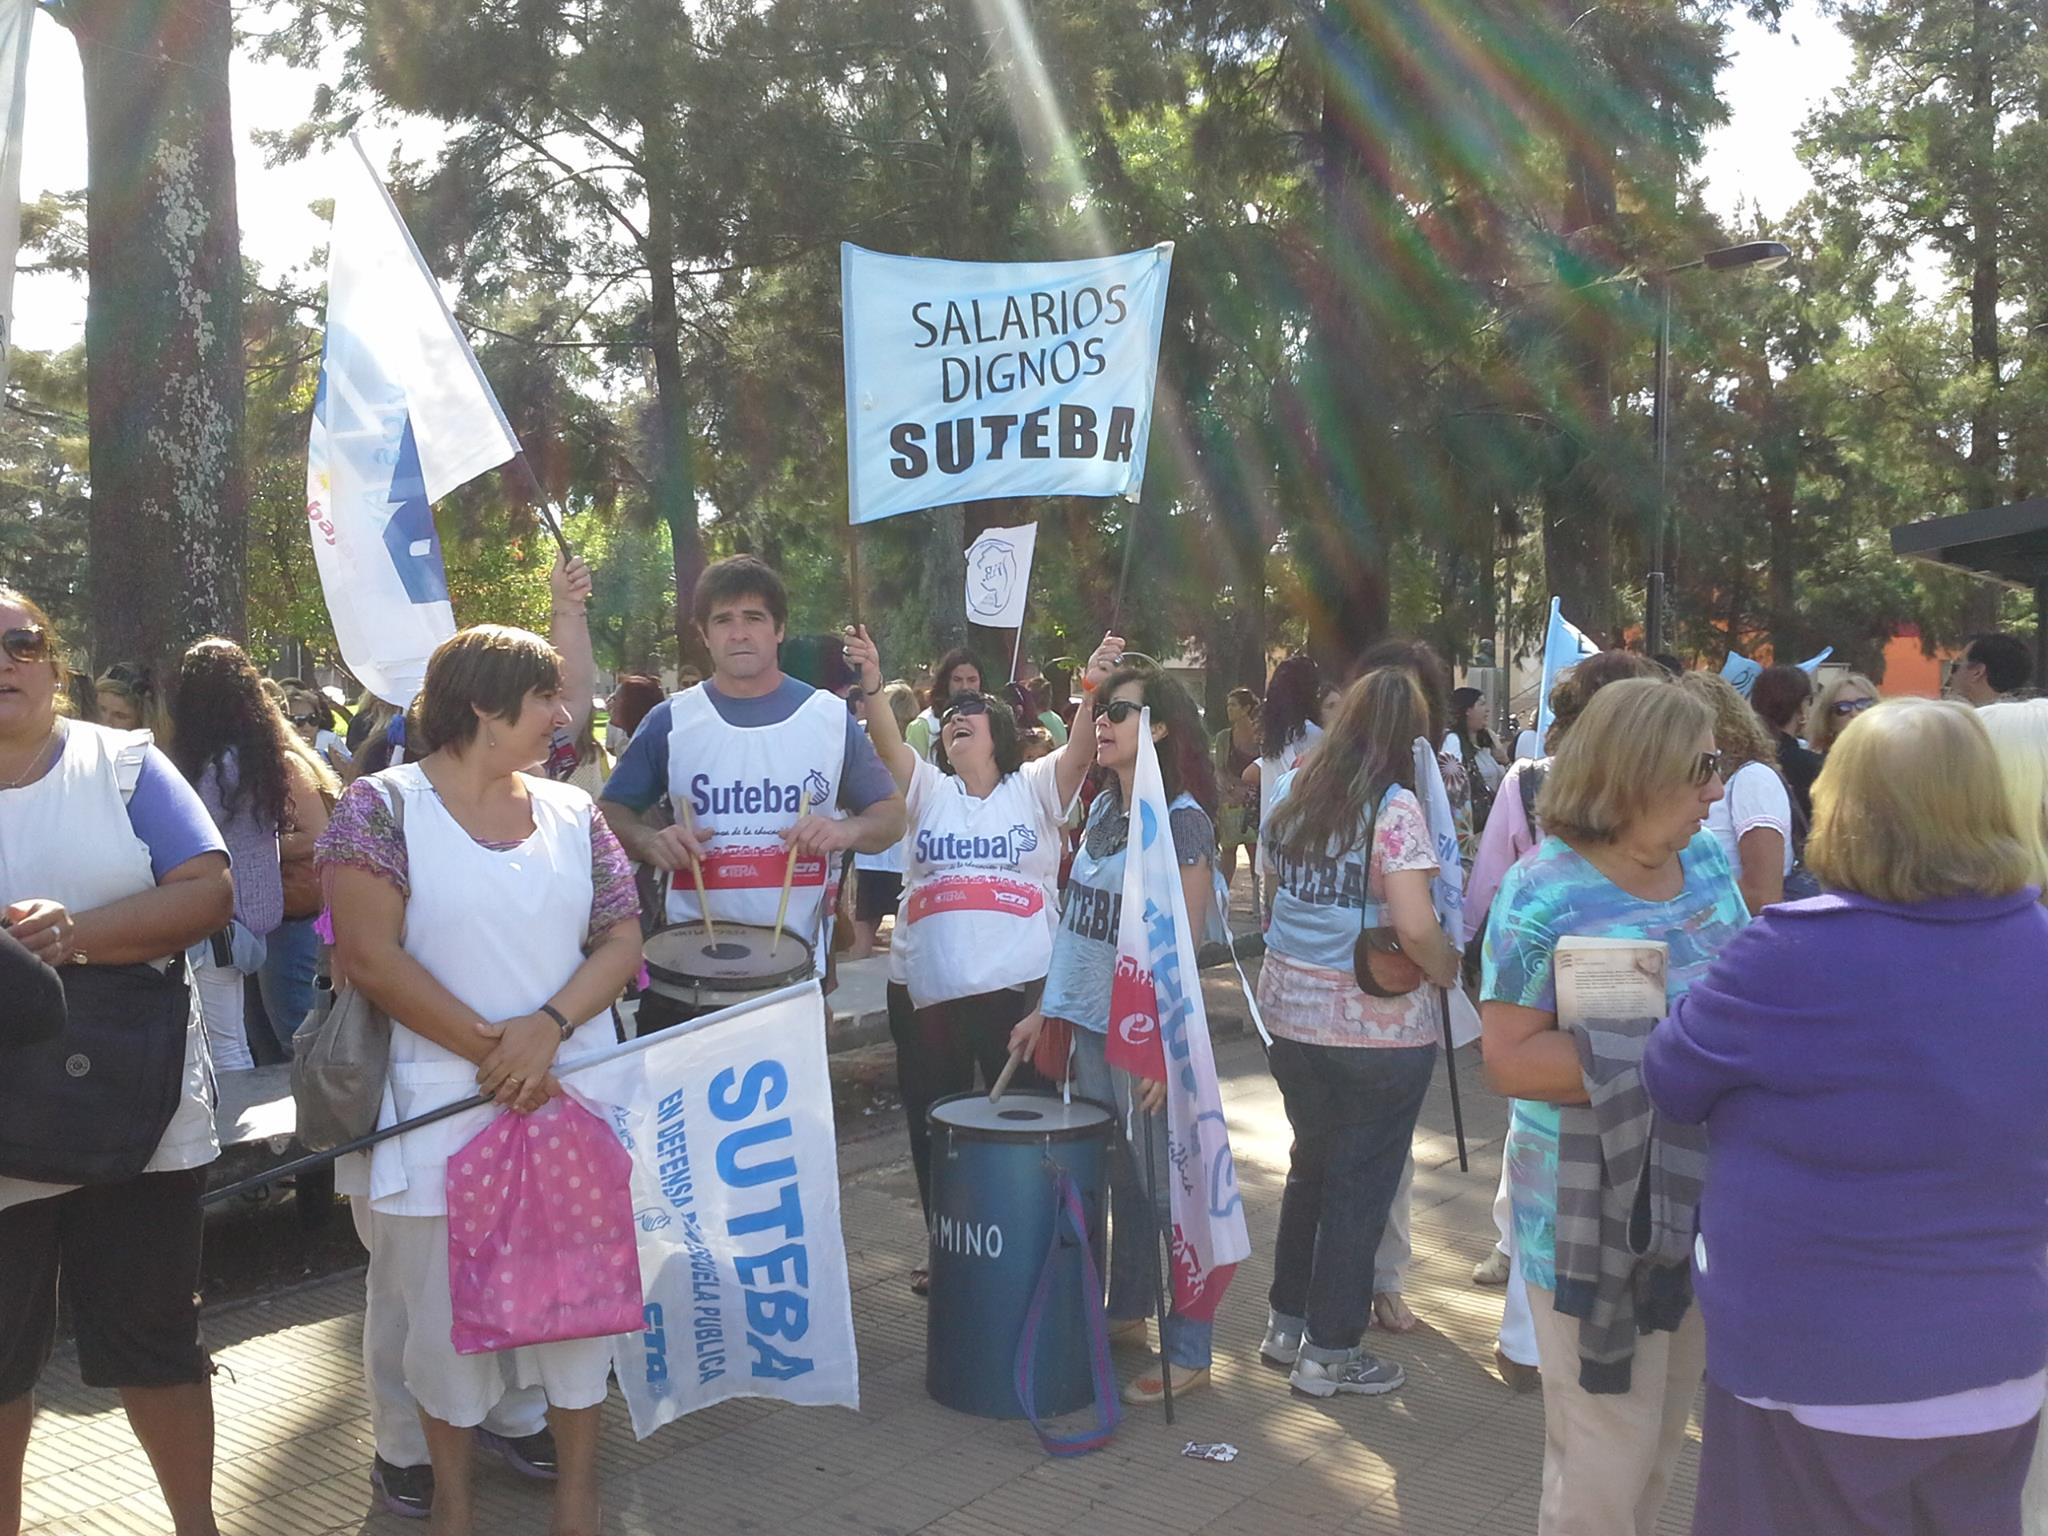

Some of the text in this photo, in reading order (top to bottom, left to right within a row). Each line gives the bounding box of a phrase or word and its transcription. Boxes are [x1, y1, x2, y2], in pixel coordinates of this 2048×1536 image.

[912, 284, 1127, 348] SALARIOS
[941, 337, 1106, 404] DIGNOS
[889, 403, 1135, 480] SUTEBA
[691, 774, 800, 816] Suteba
[915, 830, 1007, 864] Suteba
[657, 1087, 684, 1125] EN
[657, 1118, 694, 1208] DEFENSA
[708, 1059, 814, 1383] SUTEBA
[931, 1212, 1003, 1259] AMINO
[693, 1306, 726, 1385] PUBLICA
